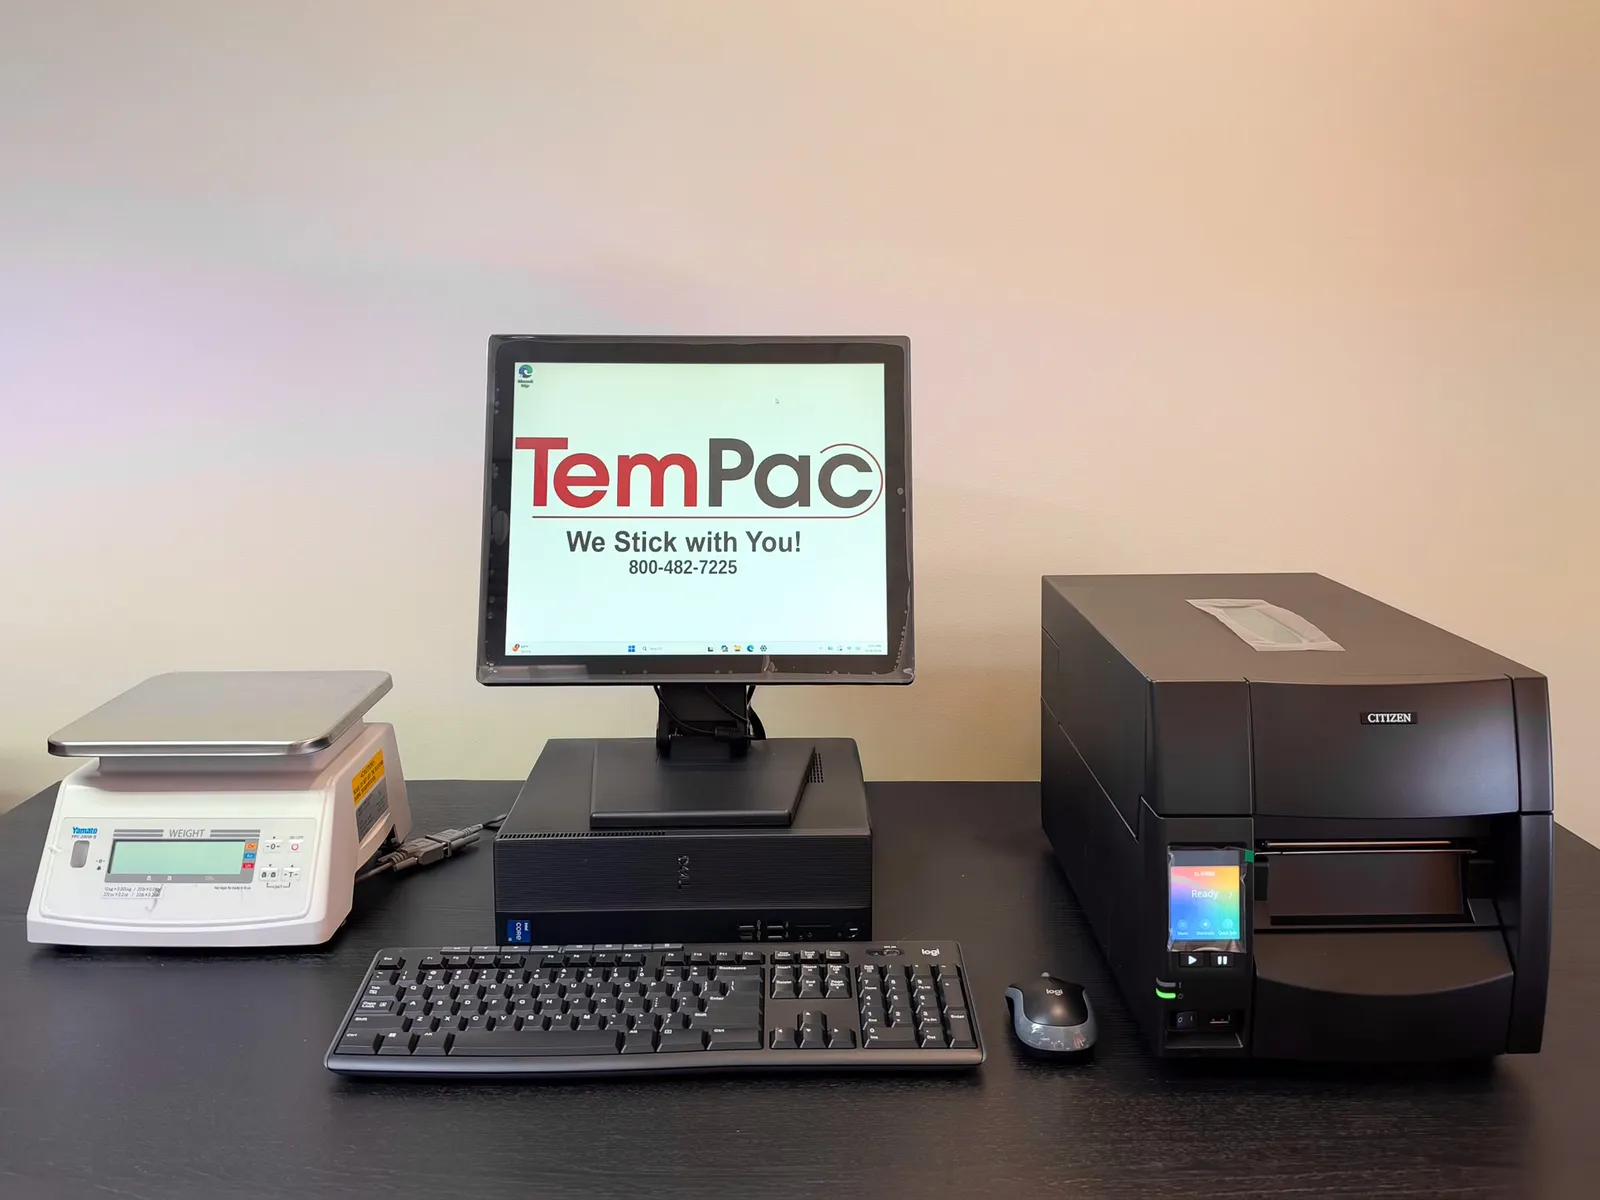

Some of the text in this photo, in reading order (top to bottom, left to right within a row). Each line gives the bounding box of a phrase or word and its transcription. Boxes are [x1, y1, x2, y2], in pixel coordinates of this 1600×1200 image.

[515, 437, 873, 509] TemPac
[566, 531, 801, 552] We Stick with You!
[629, 560, 737, 575] 800-482-7225
[1368, 714, 1412, 722] CITIZEN
[1192, 890, 1218, 900] Ready
